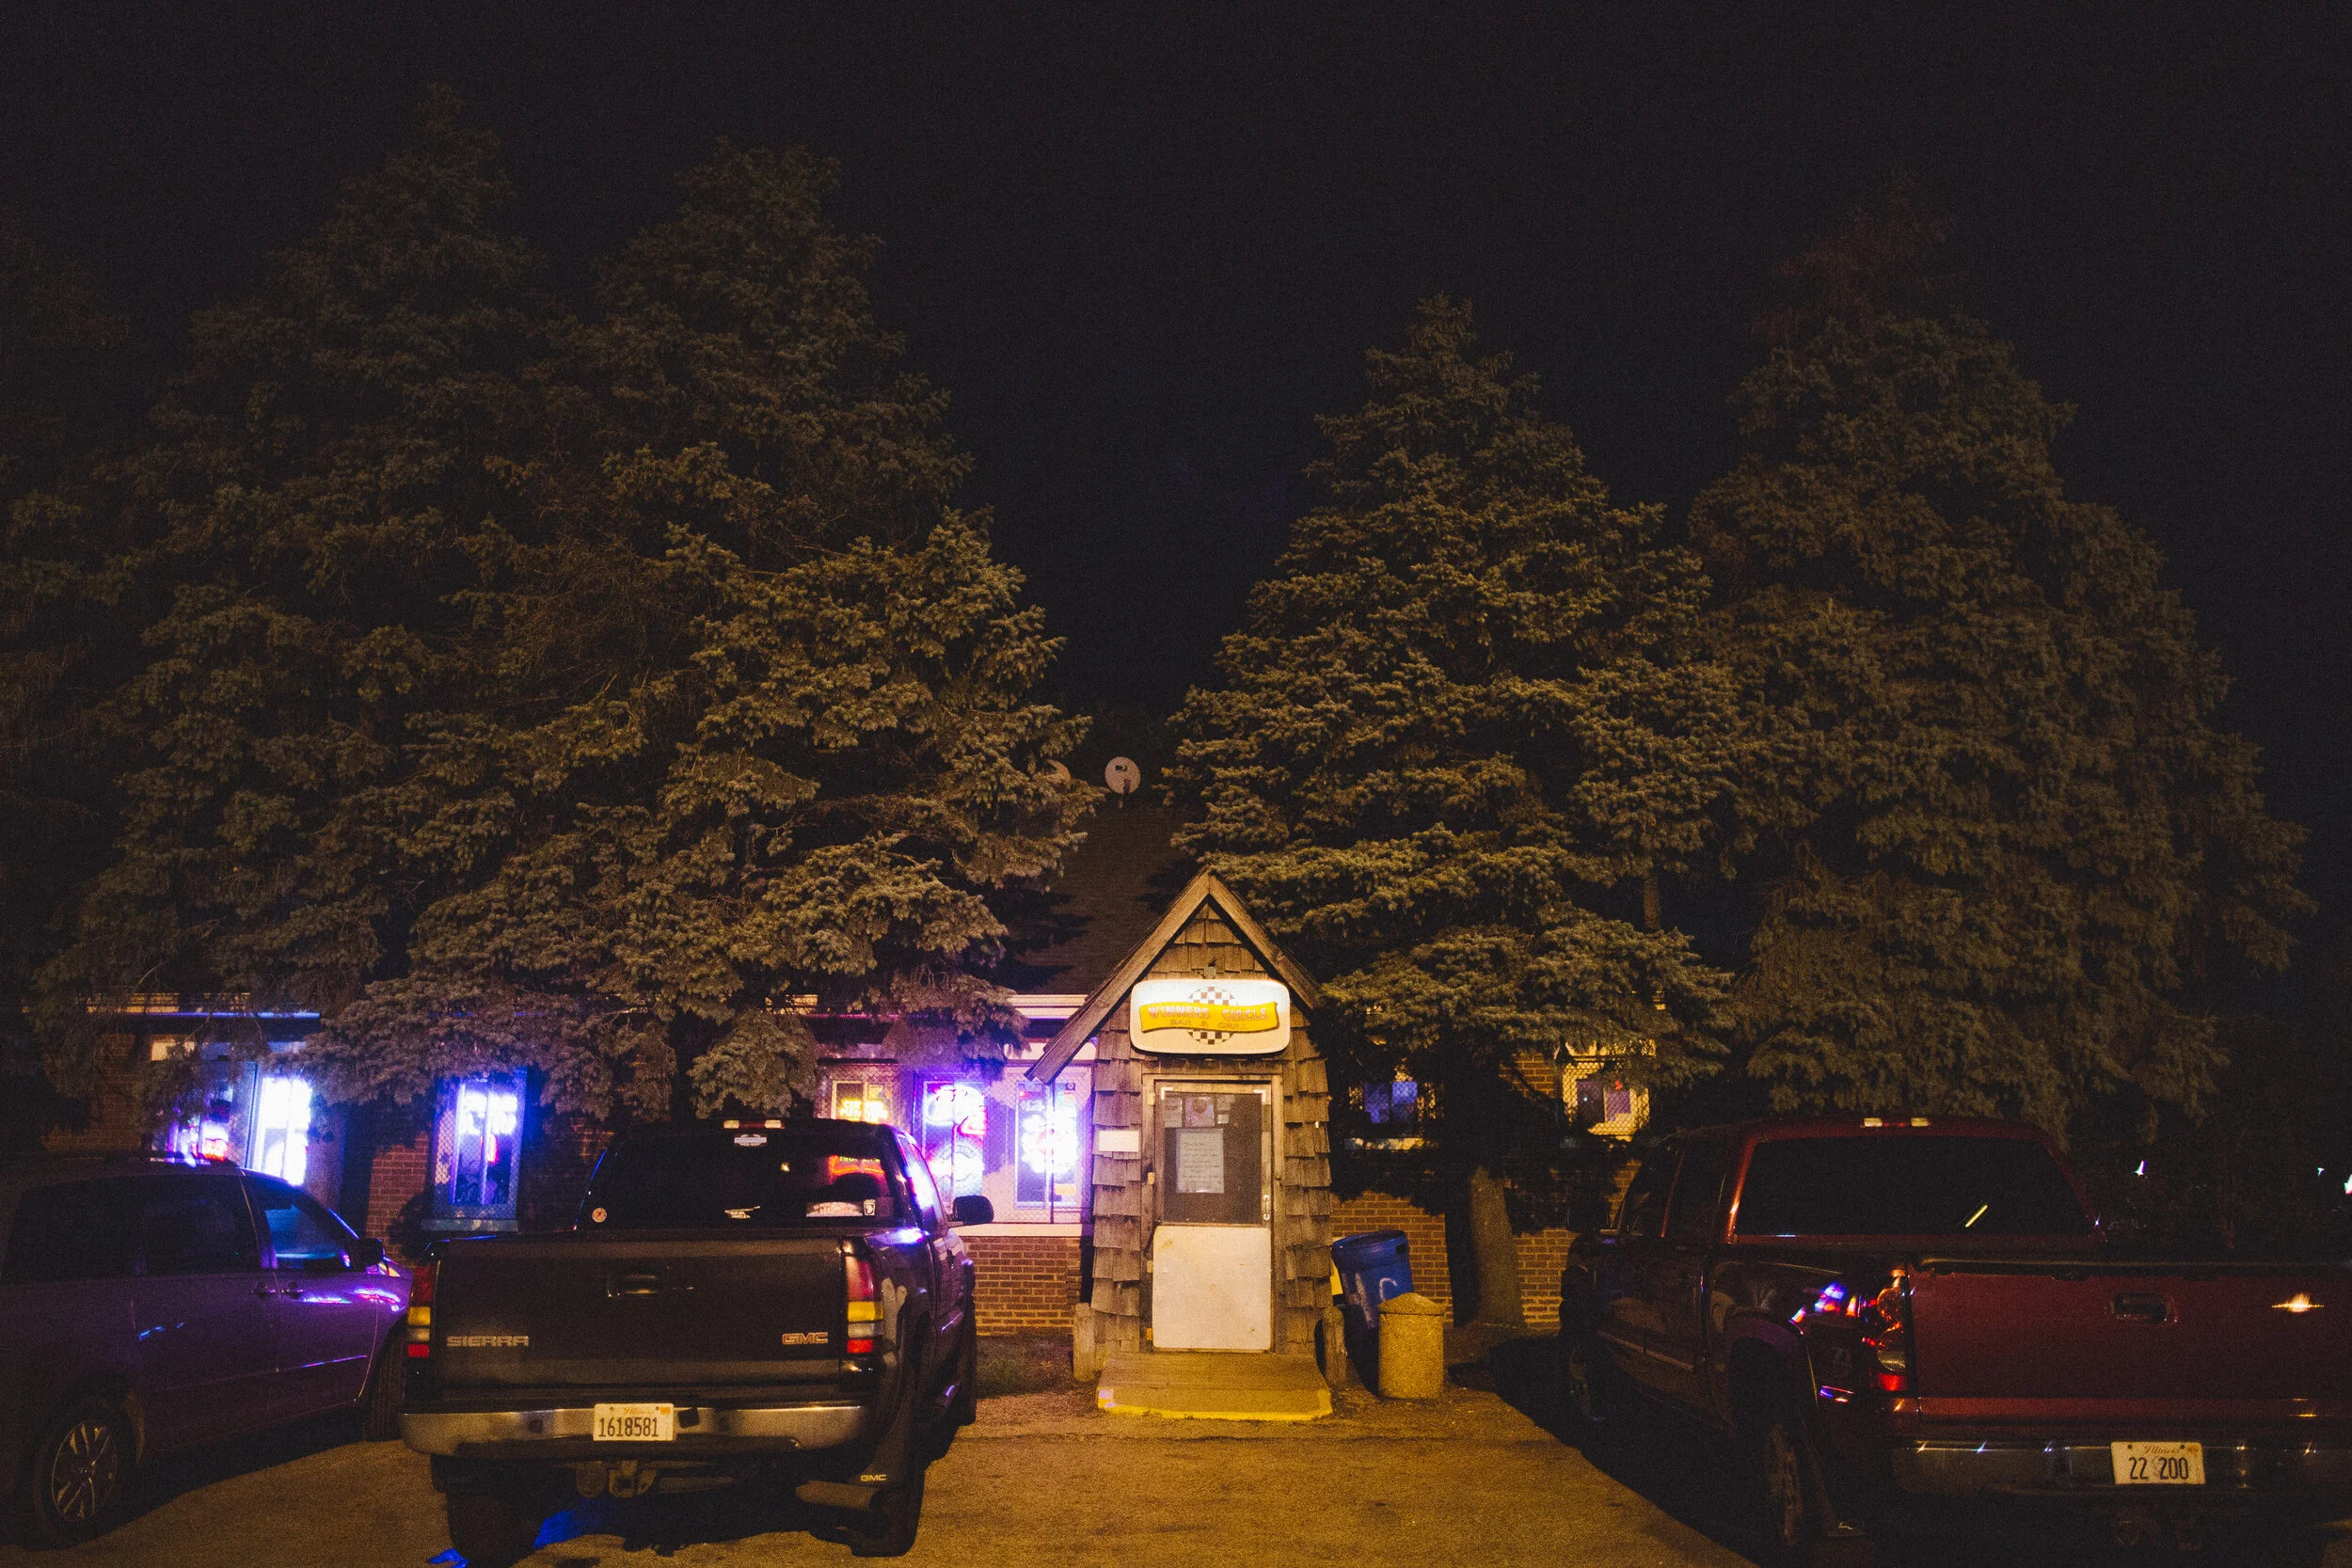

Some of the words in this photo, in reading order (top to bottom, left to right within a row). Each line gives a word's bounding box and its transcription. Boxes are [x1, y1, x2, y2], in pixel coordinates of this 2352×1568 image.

[1148, 1005, 1211, 1020] WINNERS
[1221, 1006, 1268, 1022] CIRCLE
[1169, 1019, 1192, 1027] BAR
[446, 1335, 530, 1347] SIERRA
[782, 1332, 829, 1345] GMC
[597, 1417, 660, 1437] 1618581
[2128, 1456, 2150, 1481] 22
[2158, 1456, 2189, 1481] 200
[860, 1473, 888, 1482] GMC
